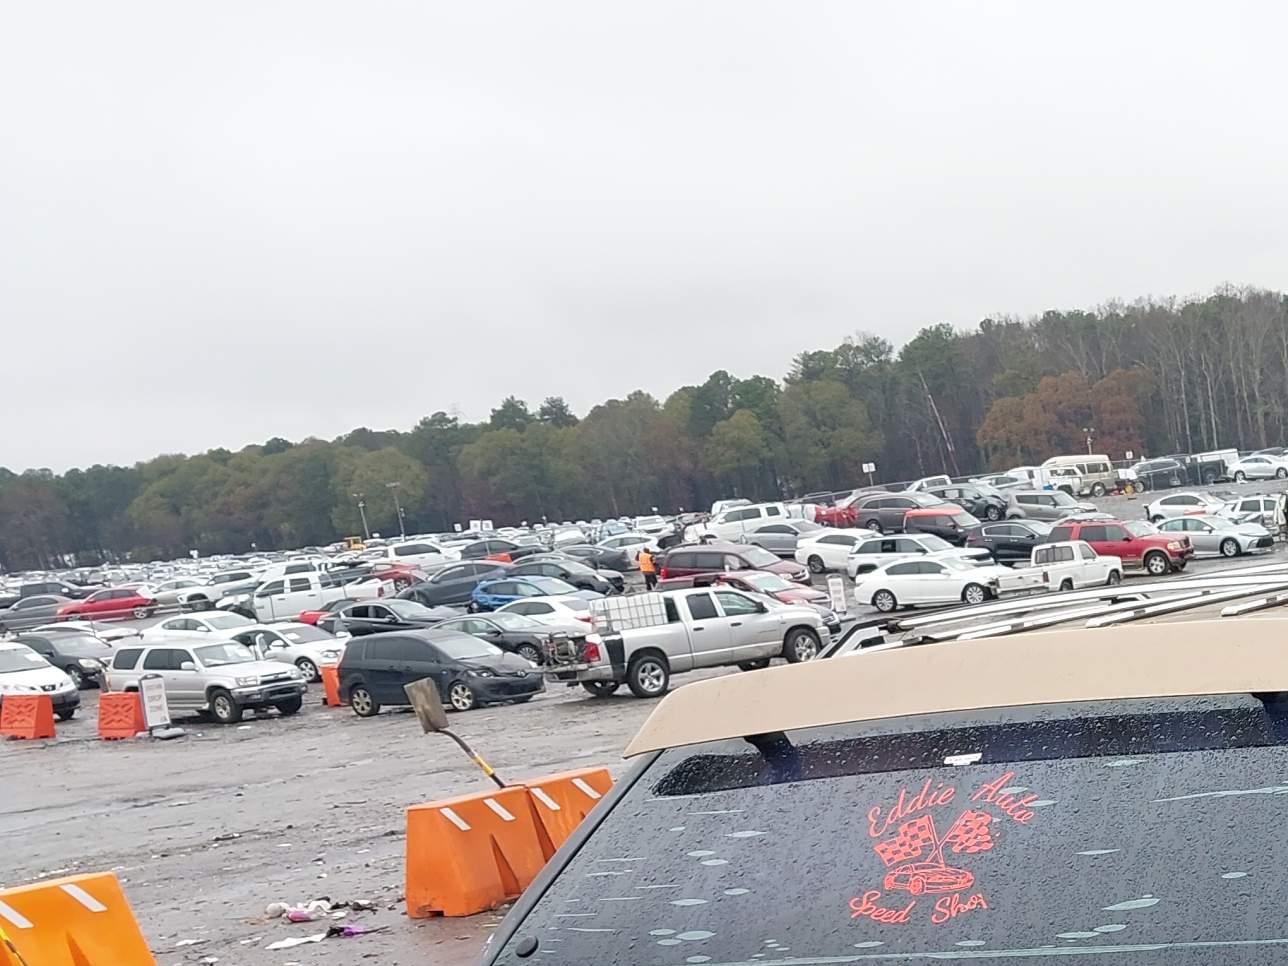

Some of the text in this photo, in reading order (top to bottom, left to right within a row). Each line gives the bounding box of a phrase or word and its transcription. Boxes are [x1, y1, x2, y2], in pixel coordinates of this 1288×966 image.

[868, 770, 1039, 837] Eddie Auto
[849, 890, 916, 923] Speed
